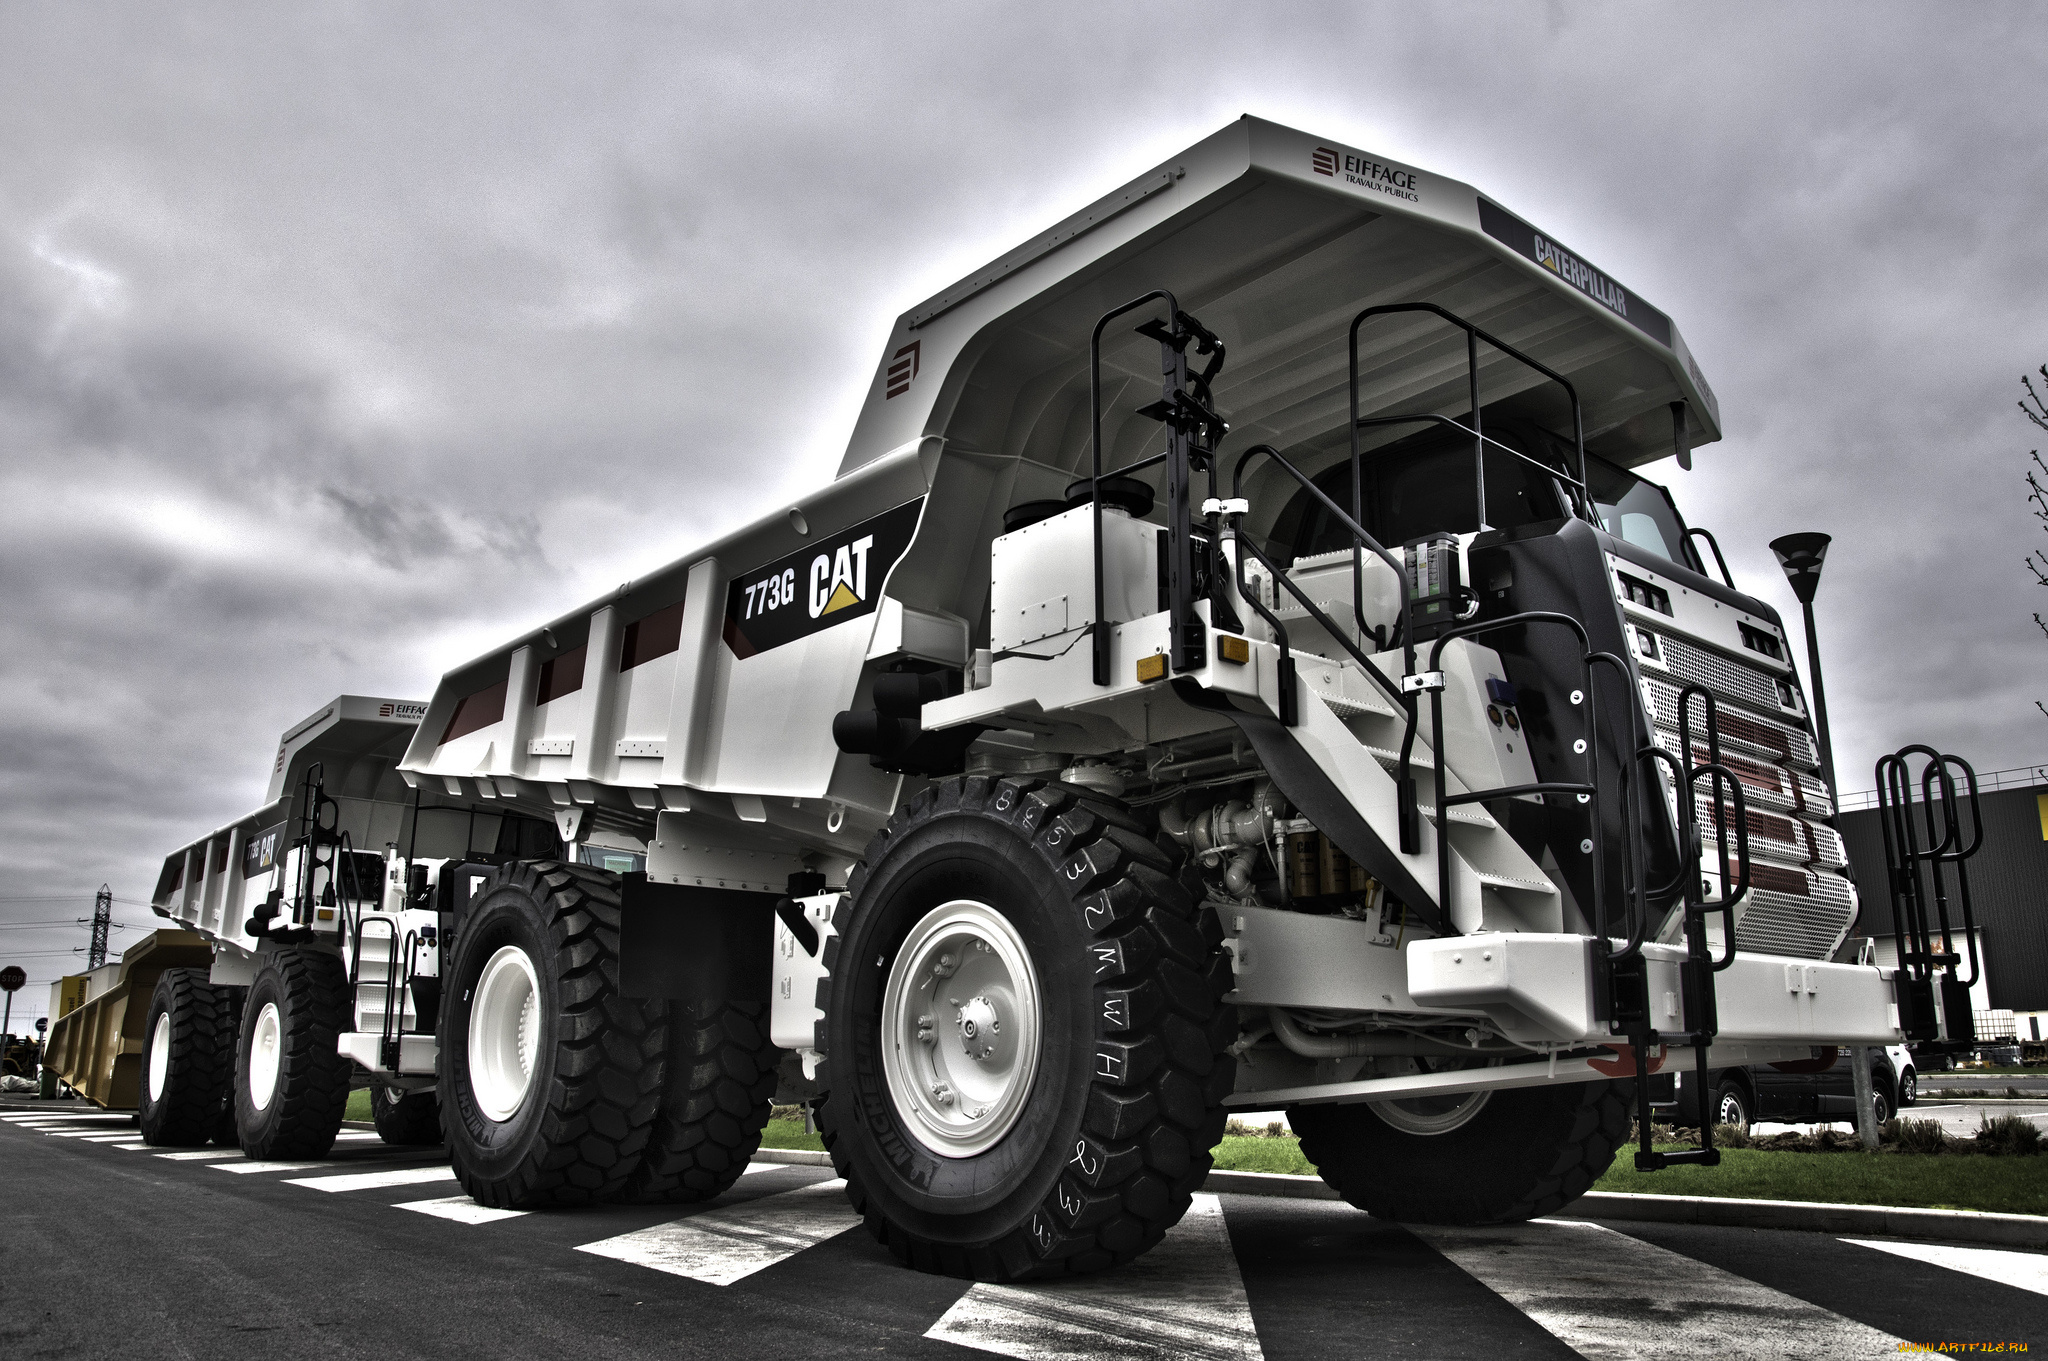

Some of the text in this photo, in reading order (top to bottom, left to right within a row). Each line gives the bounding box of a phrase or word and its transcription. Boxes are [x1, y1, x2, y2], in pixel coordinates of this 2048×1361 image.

[1345, 154, 1417, 191] EIFFAGE
[1345, 173, 1419, 203] TRAVAUX PUBLICS
[1533, 234, 1627, 317] CATERPILLAR
[745, 534, 874, 620] 773G CAT
[259, 833, 276, 868] CAT
[1, 974, 24, 983] STOP
